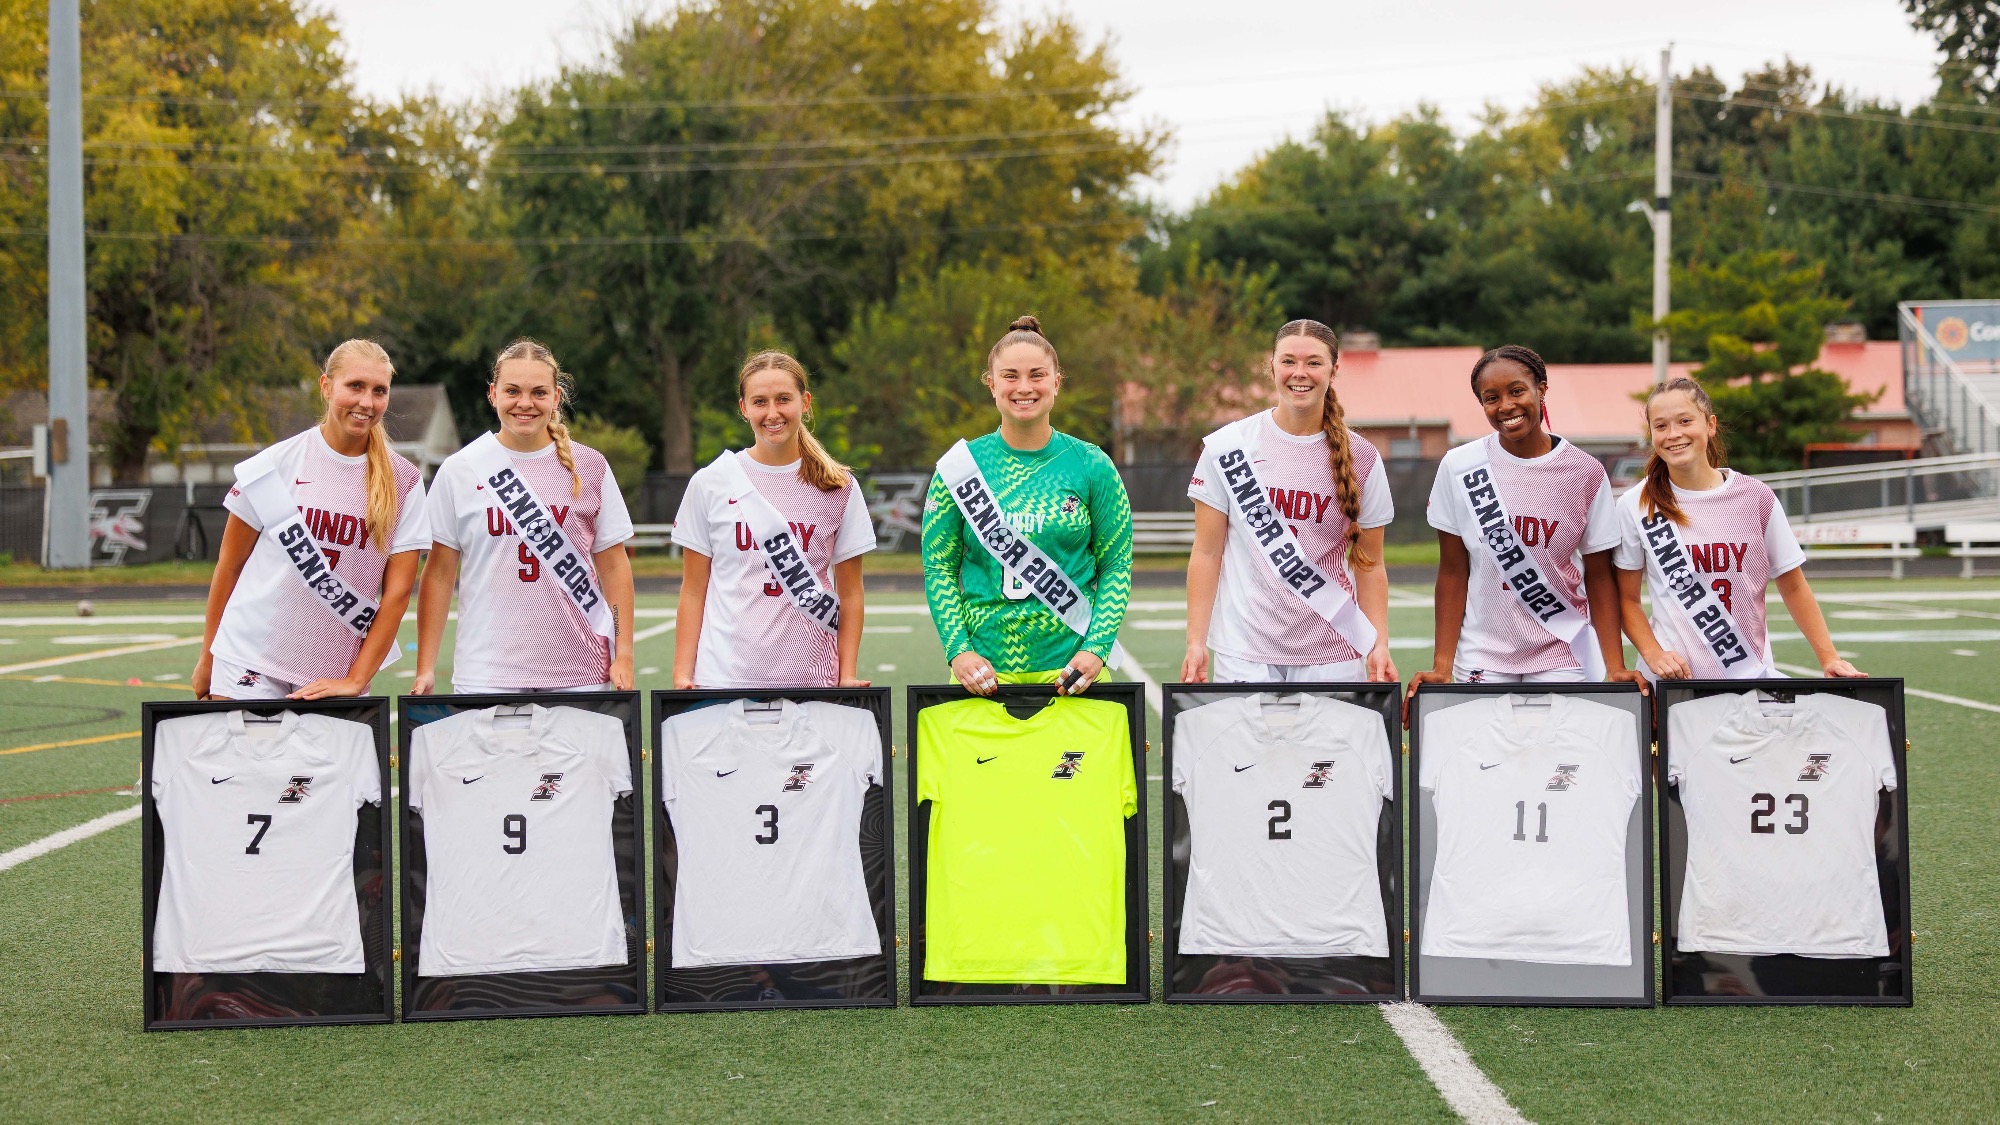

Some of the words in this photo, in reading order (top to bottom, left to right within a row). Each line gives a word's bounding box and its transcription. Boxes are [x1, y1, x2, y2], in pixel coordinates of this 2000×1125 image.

[488, 468, 565, 560] SENIOR
[552, 552, 599, 614] 2027
[956, 476, 1029, 568] SENIOR
[1020, 557, 1079, 615] 2027
[1218, 449, 1284, 547] SENIOR
[1269, 542, 1327, 599] 2027
[1463, 468, 1526, 572] SENIOR
[1511, 567, 1567, 624] 2027
[278, 522, 359, 617] SENIOR
[764, 532, 835, 621] SENIOR
[1641, 511, 1707, 610] SENIOR
[1692, 604, 1748, 669] 2027
[245, 813, 272, 856] 7
[503, 813, 527, 855] 9
[755, 804, 779, 845] 3
[1267, 799, 1292, 840] 2
[1513, 800, 1549, 843] 11
[1750, 792, 1809, 835] 23
